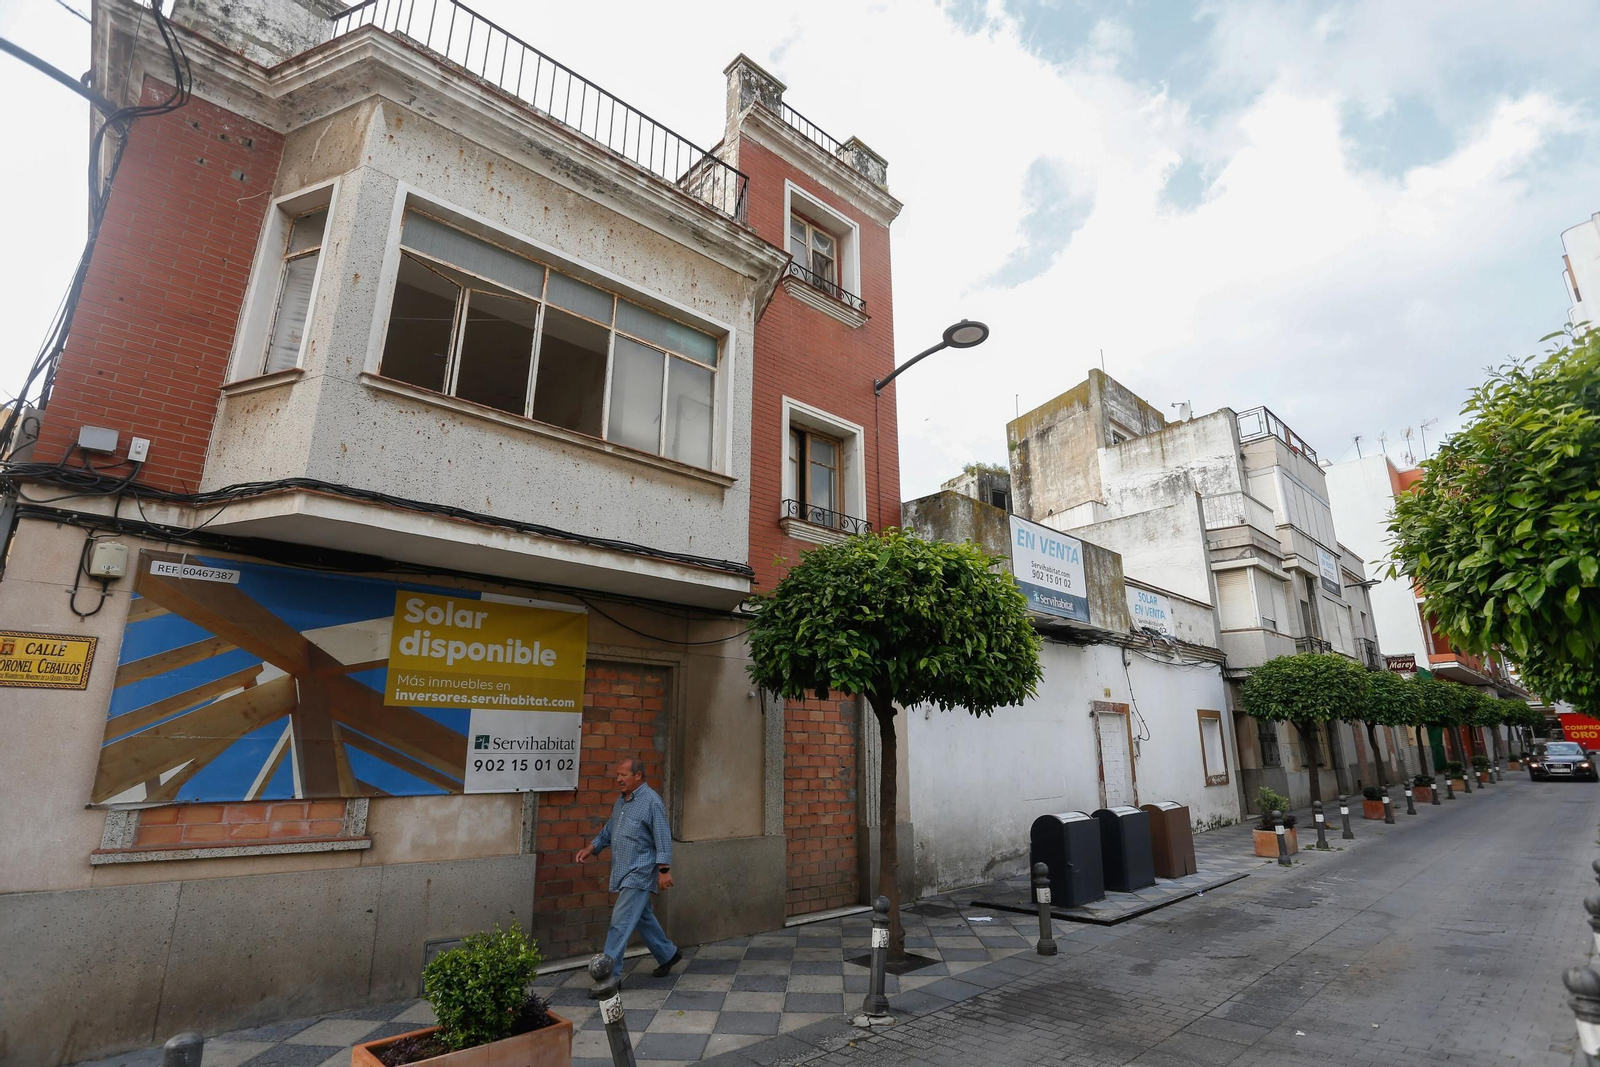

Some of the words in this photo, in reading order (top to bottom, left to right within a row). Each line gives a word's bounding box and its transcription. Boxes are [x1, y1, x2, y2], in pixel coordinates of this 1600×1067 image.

[1017, 528, 1035, 551] EN
[1040, 536, 1080, 565] VENTA
[157, 564, 179, 574] REF.
[182, 567, 234, 580] 60467387
[1030, 560, 1070, 579] Servihabitat.com
[1031, 569, 1044, 581] 902
[1046, 573, 1053, 584] 15
[1055, 576, 1062, 586] 01
[1063, 579, 1071, 588] 02
[1039, 593, 1073, 611] Servihabitat
[1138, 591, 1158, 605] SOLAR
[403, 598, 488, 629] Solar
[1135, 604, 1143, 615] EN
[1144, 606, 1166, 619] VENTA
[25, 642, 67, 657] CALLE
[399, 629, 557, 667] disponible
[37, 658, 81, 675] CEBALLOS
[1388, 659, 1414, 669] Marey
[397, 674, 425, 687] Más
[428, 675, 494, 690] inmuebles
[496, 681, 511, 691] en
[395, 688, 575, 708] inversores.servihabitat.com
[492, 736, 576, 750] Servihabitat
[474, 759, 505, 772] 902
[511, 759, 528, 771] 15
[534, 759, 551, 771] 01
[557, 759, 573, 771] 02
